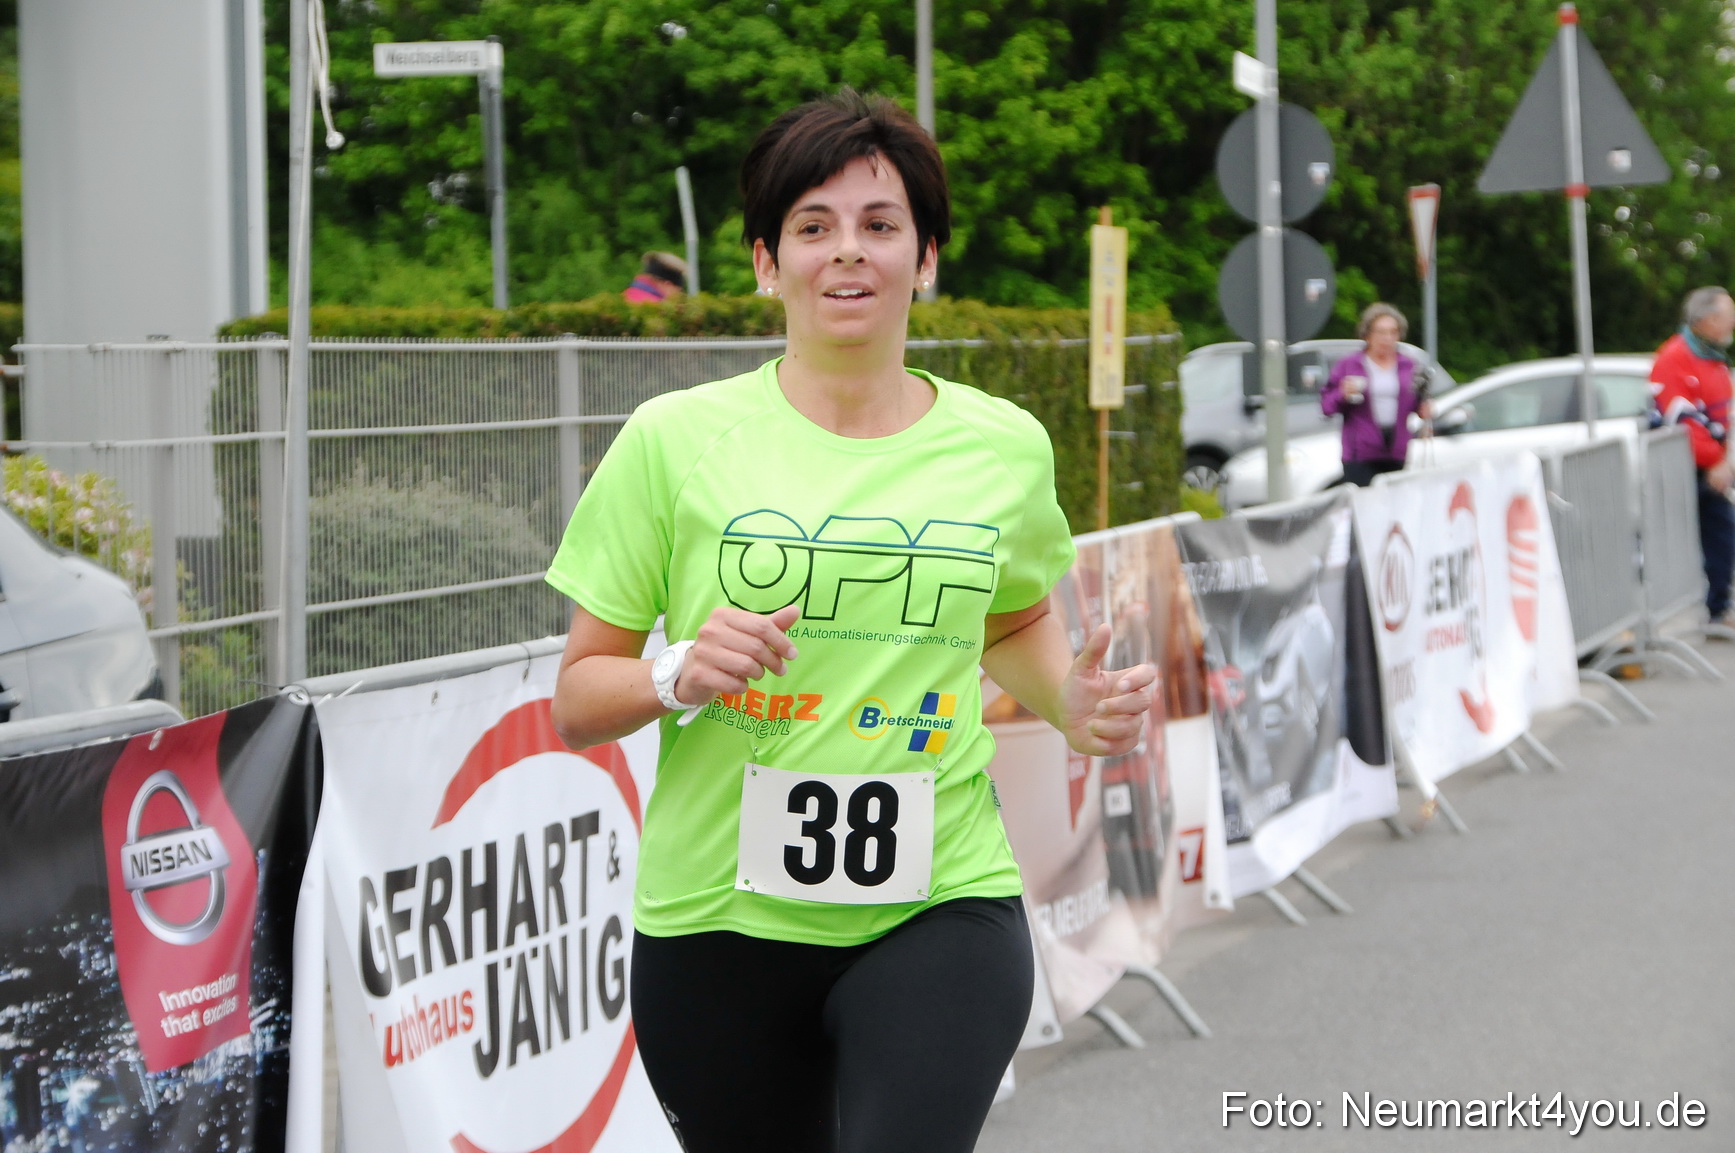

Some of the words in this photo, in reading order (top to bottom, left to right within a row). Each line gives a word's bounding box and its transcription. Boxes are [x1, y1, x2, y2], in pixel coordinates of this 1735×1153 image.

[801, 627, 947, 646] Automatisierungstechnik
[950, 636, 977, 650] GmbH
[705, 697, 791, 738] Reisen
[858, 706, 955, 730] Bretschneid
[783, 780, 899, 887] 38
[129, 838, 213, 880] NISSAN
[358, 809, 600, 999] GERHART
[606, 829, 621, 884] &
[158, 972, 239, 1012] Innovation
[472, 914, 626, 1081] JÄNIG
[160, 1010, 200, 1038] that
[202, 996, 239, 1026] excites
[370, 989, 474, 1068] utohaus
